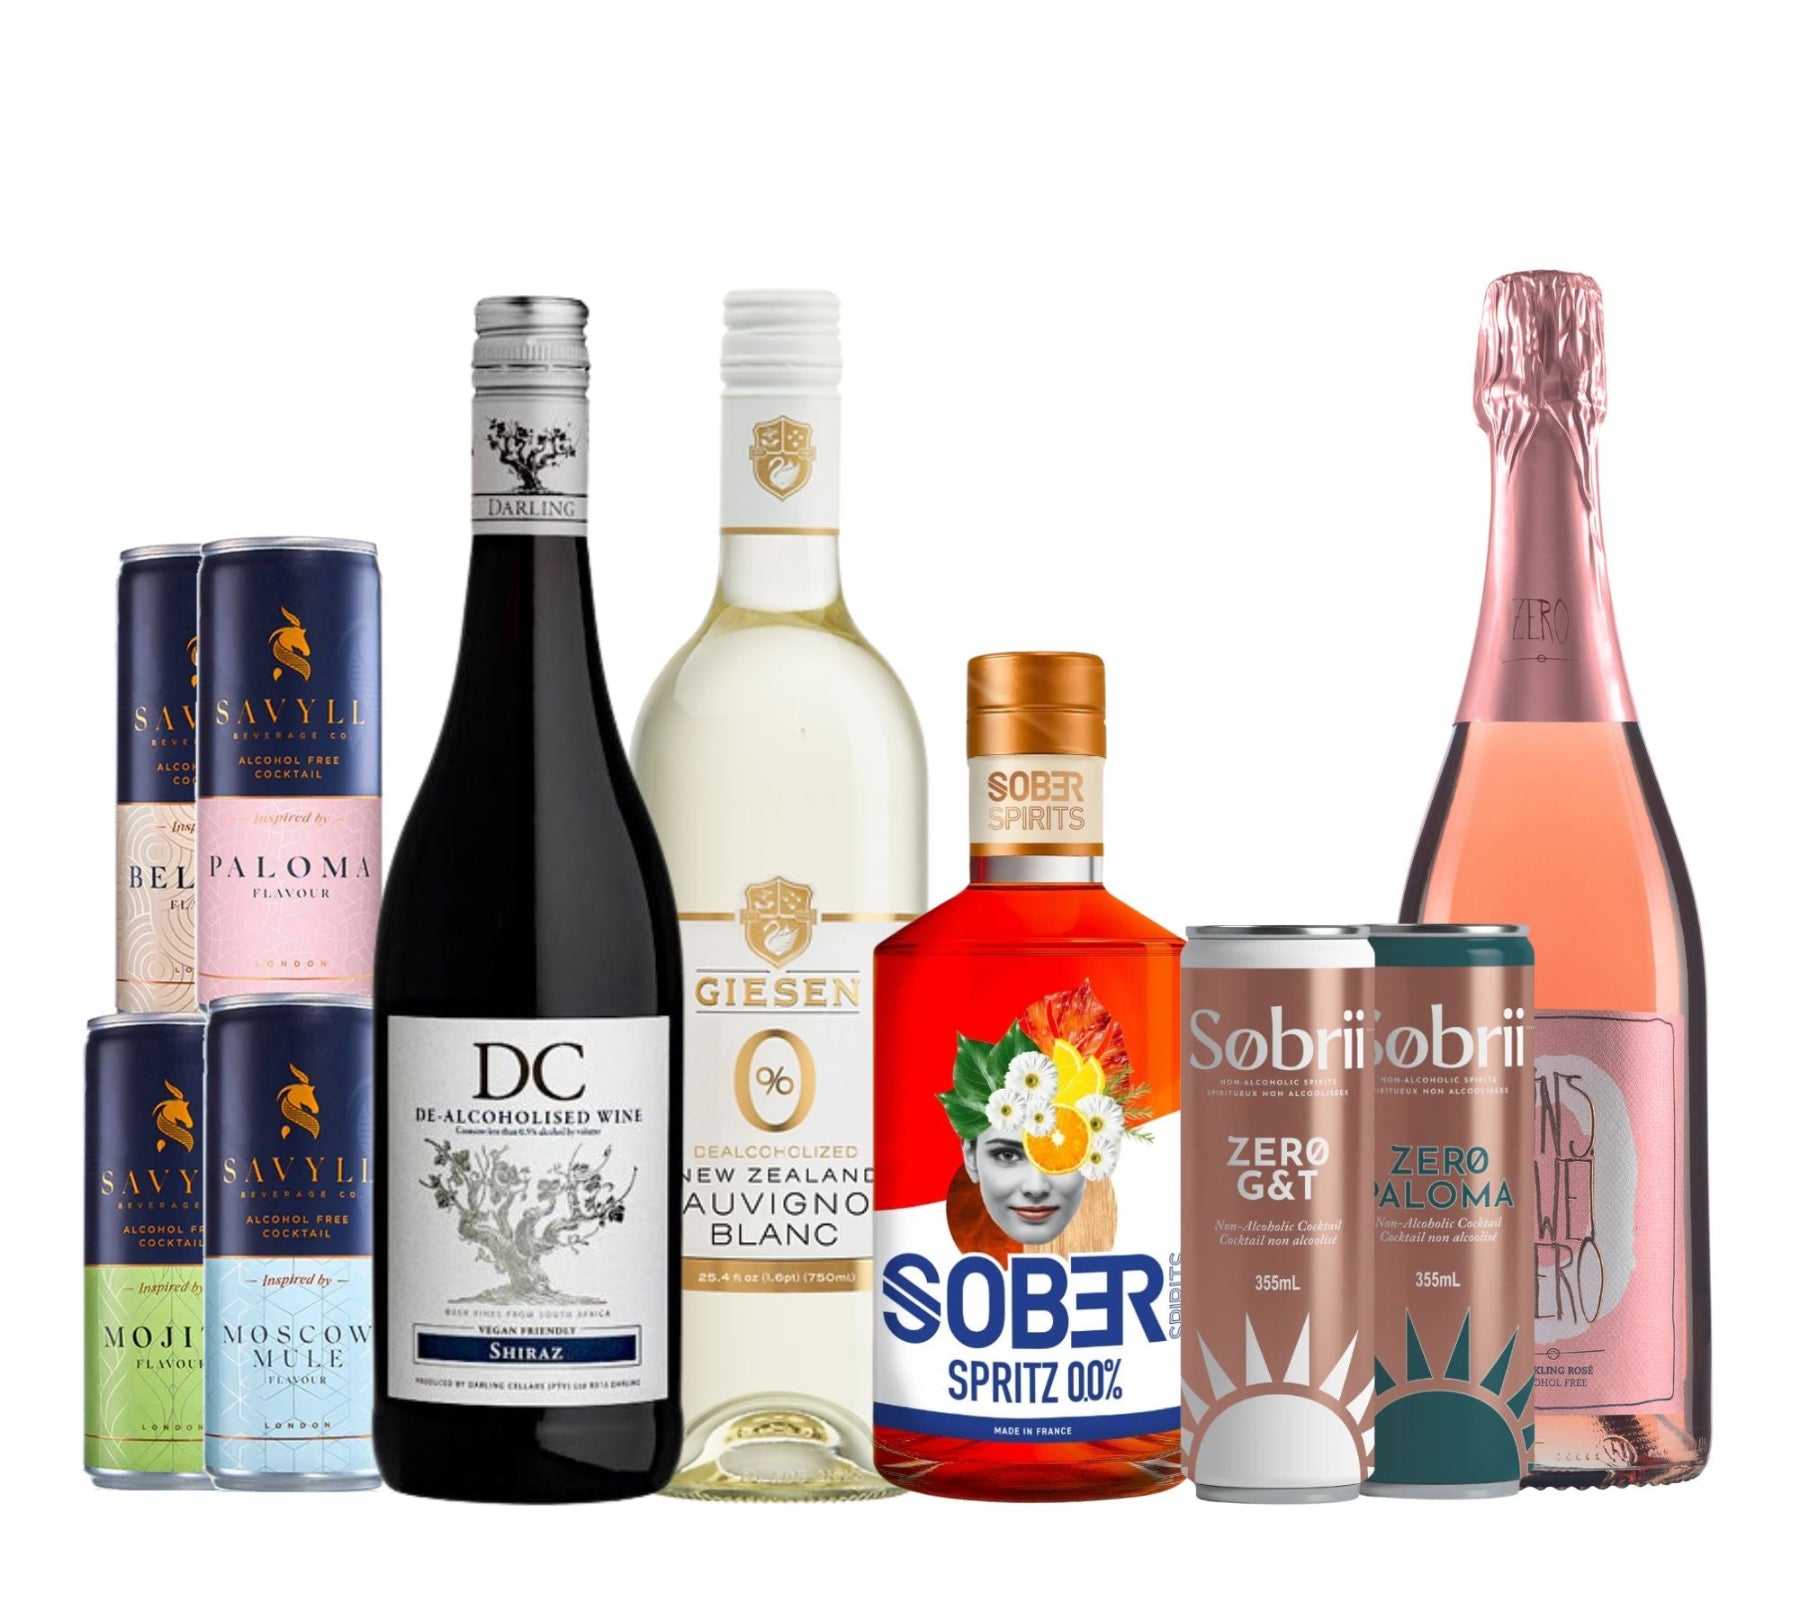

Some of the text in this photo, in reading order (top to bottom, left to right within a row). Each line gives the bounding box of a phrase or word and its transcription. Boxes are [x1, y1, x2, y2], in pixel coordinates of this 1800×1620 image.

[488, 498, 575, 517] DARLING
[1511, 597, 1570, 645] ZERO
[215, 698, 366, 726] SAVYLL
[233, 732, 318, 740] BEVERAGE
[238, 756, 340, 766] ALCOHOL FREE
[255, 769, 322, 779] COCKTAIL
[987, 770, 1085, 802] SOBER
[253, 812, 330, 826] Inspired by
[988, 806, 1085, 830] SPIRITS
[210, 855, 370, 878] PALOMA
[130, 865, 196, 889] BEL
[253, 888, 330, 898] FLAVOUR
[256, 960, 328, 968] LONDON
[695, 976, 860, 1007] GIESEN
[472, 1042, 586, 1101] DC
[1303, 1078, 1337, 1086] SPIRITS
[1422, 1088, 1445, 1096] NON
[415, 1107, 643, 1125] DE-ALCOHOLISED WINE
[694, 1145, 859, 1159] DEALCOHOLIZED
[223, 1157, 374, 1184] SAVYLL
[748, 1167, 874, 1183] ZEALAND
[101, 1169, 199, 1196] SAVY
[1237, 1169, 1319, 1201] G&T
[246, 1215, 349, 1224] ALCOHOL FREE
[1214, 1218, 1343, 1232] Non-Alcoholic Cocktail
[1375, 1216, 1503, 1229] Non-Alcoholic Cocktail
[123, 1225, 183, 1234] ALCOHOL
[263, 1229, 331, 1238] COCKTAIL
[711, 1222, 838, 1246] BLANC
[1380, 1230, 1425, 1243] Cocktail
[1428, 1234, 1450, 1243] non
[139, 1238, 204, 1248] COCKTAIL
[1219, 1233, 1266, 1246] Cocktail
[1267, 1237, 1289, 1246] non
[262, 1274, 333, 1289] Inspired by
[698, 1272, 730, 1282] 25.4
[744, 1273, 760, 1282] oz
[1255, 1274, 1301, 1291] 355mL
[1415, 1271, 1461, 1288] 355mL
[139, 1280, 189, 1295] Inspired
[882, 1252, 1168, 1349] SOBER
[105, 1325, 204, 1349] MOJI
[224, 1324, 373, 1345] MOSCOW
[478, 1326, 577, 1335] VEGAN FRIENDLY
[253, 1349, 343, 1368] MULE
[1567, 1364, 1594, 1375] ROSÉ
[269, 1376, 327, 1384] FLAVOUR
[948, 1358, 1123, 1403] SPRITZ 0.0%
[1564, 1378, 1588, 1387] FREE
[264, 1421, 331, 1429] LONDON
[994, 1426, 1072, 1436] MADE IN FRANCE
